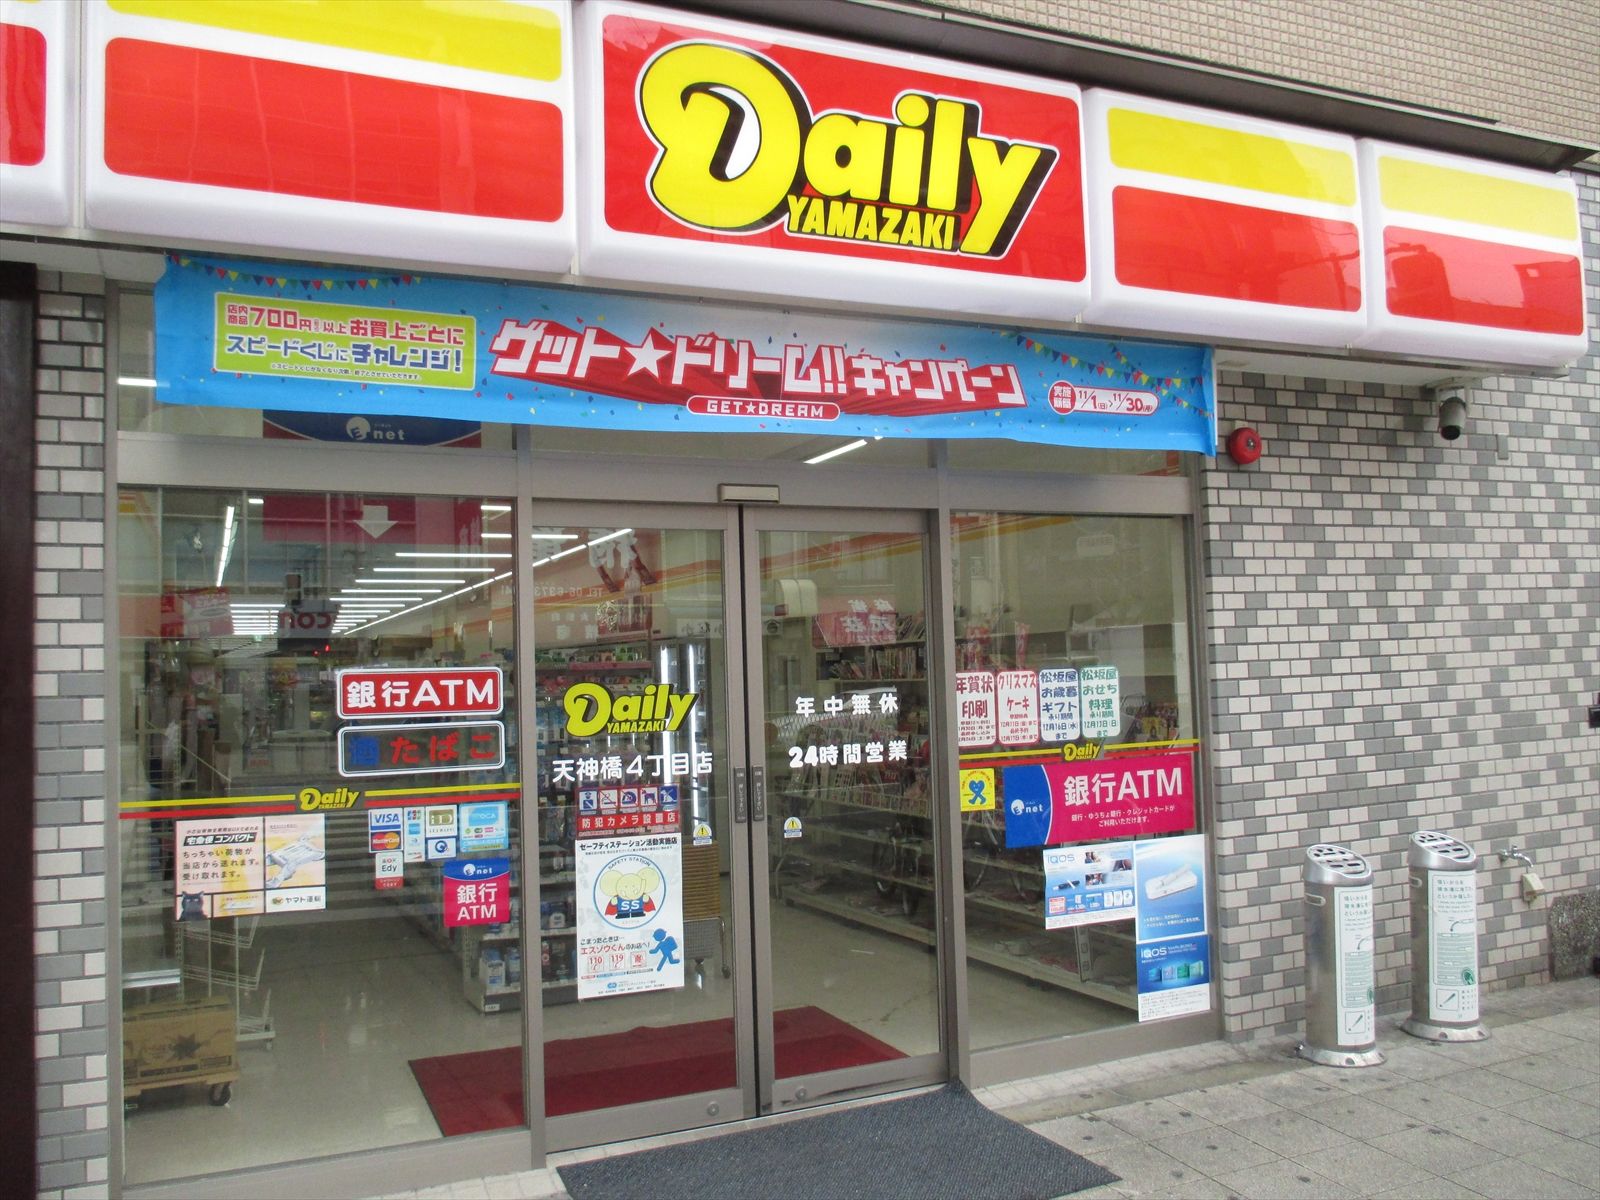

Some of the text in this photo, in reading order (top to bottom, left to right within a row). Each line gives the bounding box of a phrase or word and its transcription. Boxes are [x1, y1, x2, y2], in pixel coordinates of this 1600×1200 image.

[639, 42, 1057, 255] Daily
[787, 194, 956, 250] YAMAZAKI
[955, 675, 993, 694] 年賀状
[999, 674, 1036, 690] クリスマス
[1082, 684, 1117, 695] おせち
[346, 678, 494, 709] 銀行ATM
[1006, 695, 1030, 711] ケーキ
[563, 682, 699, 737] Daily
[795, 693, 899, 717] 年中無休
[962, 699, 988, 719] 印刷
[1041, 701, 1077, 712] ギフト
[1088, 698, 1113, 710] 料理
[606, 720, 666, 734] YAMAZAKI
[788, 739, 908, 768] 24時間営業
[1063, 742, 1100, 761] Daily
[551, 750, 713, 783] 天神橋4丁目店
[1063, 767, 1183, 807] 銀行ATM
[299, 787, 360, 811] Daily
[374, 813, 400, 823] VISA
[381, 864, 398, 873] Edy
[456, 882, 498, 904] 銀行
[456, 903, 497, 921] ATM
[620, 900, 640, 911] SS
